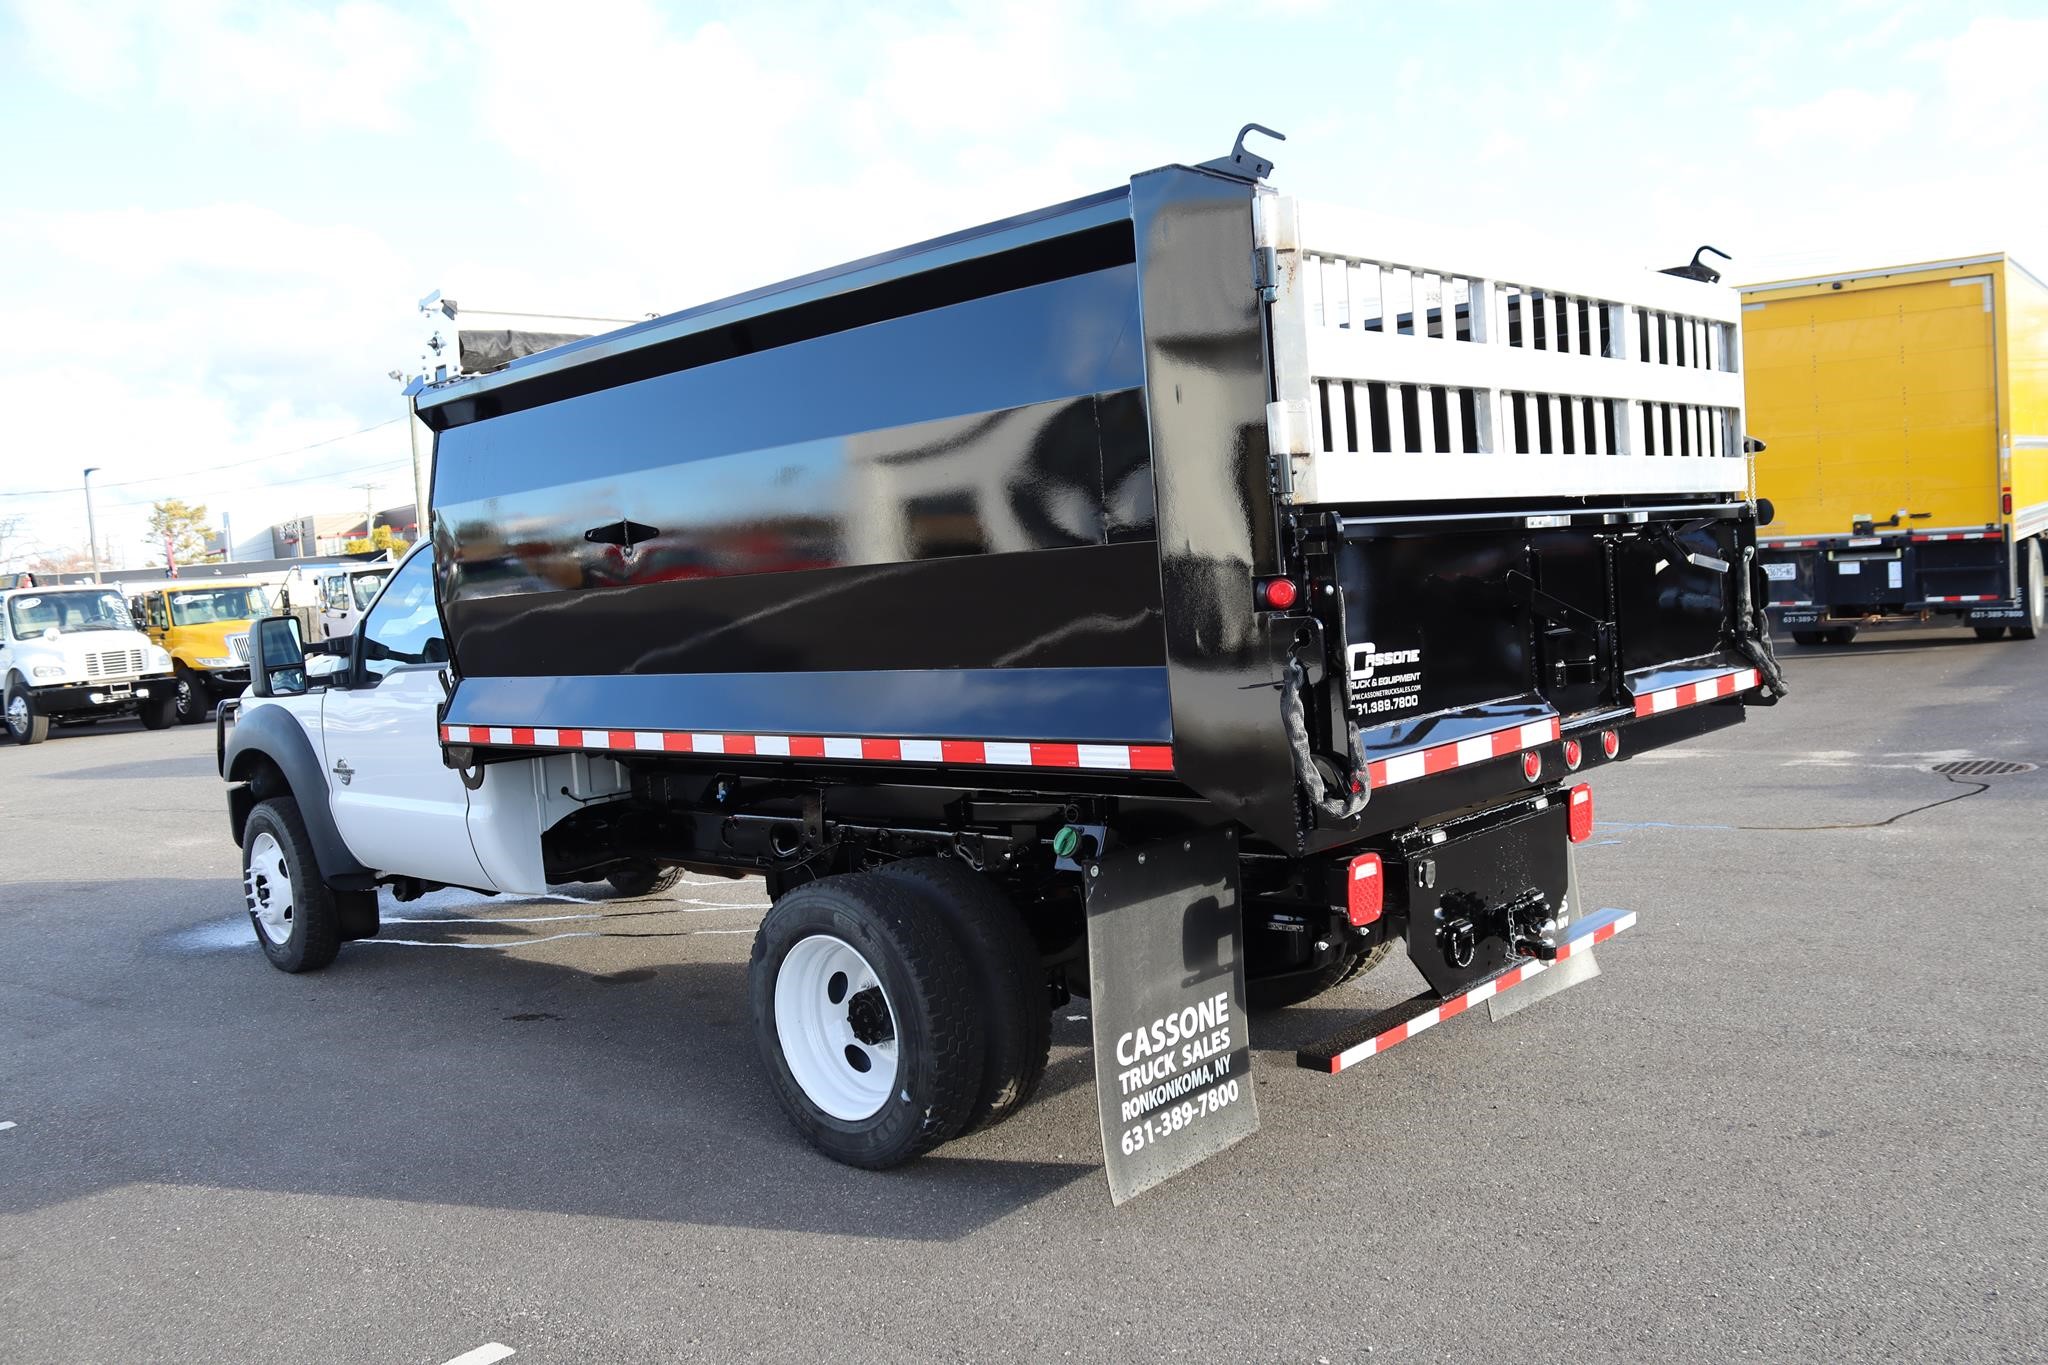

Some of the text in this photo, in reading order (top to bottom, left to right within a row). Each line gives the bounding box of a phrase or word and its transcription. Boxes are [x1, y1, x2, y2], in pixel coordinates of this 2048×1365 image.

[1350, 672, 1421, 690] RUCK & EQUIPMENT
[1350, 684, 1422, 701] WW.CASSONETRUCKSALES.COM
[1116, 992, 1229, 1066] CASSONE
[1119, 1027, 1231, 1095] TRUCK SALES
[1121, 1054, 1231, 1122] RONKONKOMA, NY
[1121, 1079, 1239, 1156] 631-389-7800
